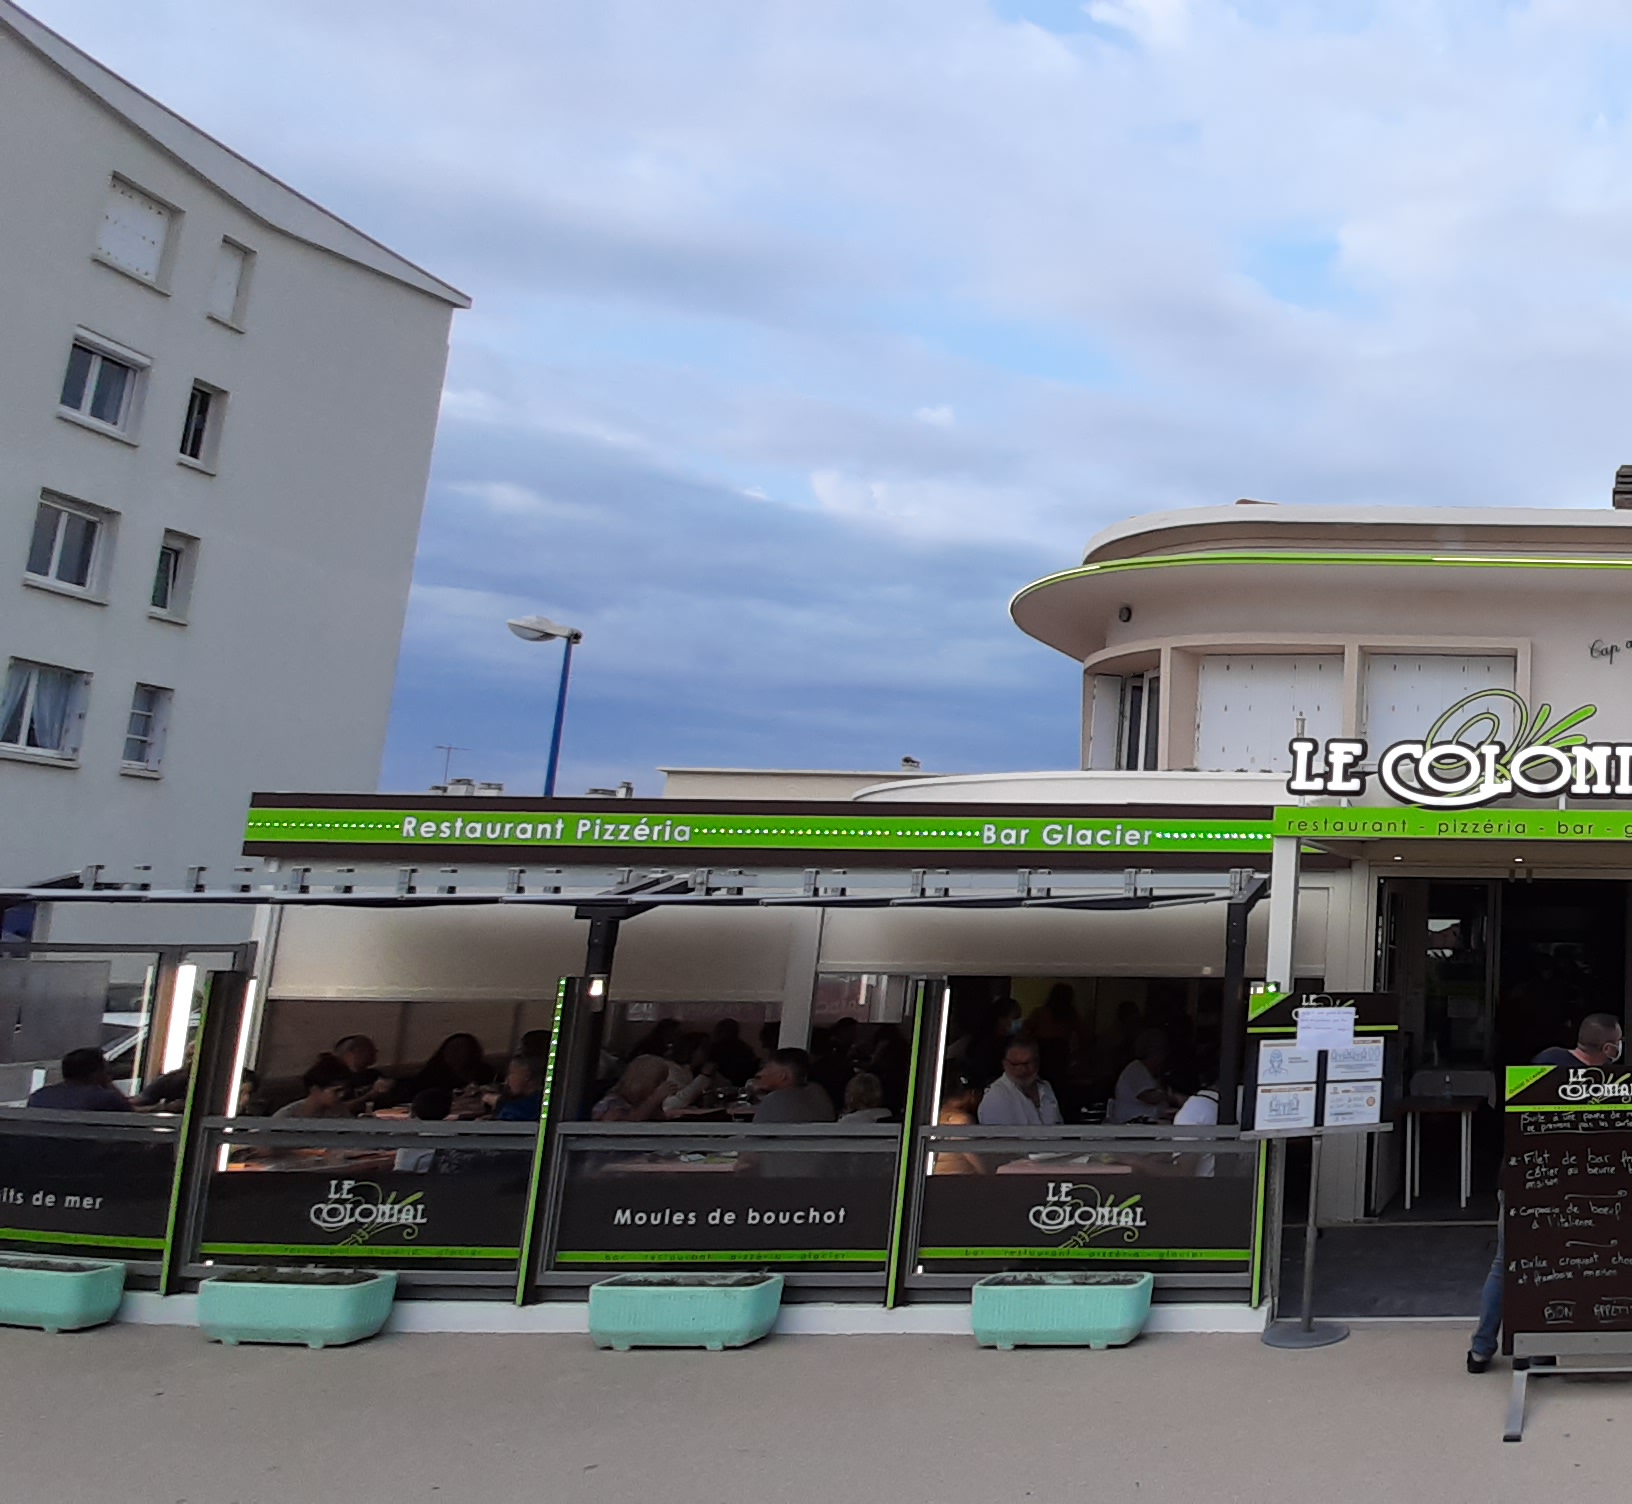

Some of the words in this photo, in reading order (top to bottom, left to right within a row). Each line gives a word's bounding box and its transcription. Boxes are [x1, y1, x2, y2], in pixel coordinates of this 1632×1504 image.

[1589, 639, 1621, 665] Cap
[1290, 740, 1364, 792] LE
[402, 816, 565, 842] Restaurant
[575, 816, 692, 843] Pizzéria
[983, 824, 1030, 845] Bar
[1042, 823, 1153, 847] Glacier
[1287, 818, 1409, 834] restaurant
[1437, 818, 1527, 837] pizzéria
[1557, 820, 1595, 836] bar
[1301, 994, 1317, 1006] LE
[1569, 1068, 1587, 1082] LE
[1610, 1111, 1624, 1119] de
[1578, 1121, 1594, 1131] pas
[1523, 1150, 1550, 1165] Filet
[1562, 1151, 1577, 1165] de
[1588, 1148, 1611, 1163] bar
[1526, 1166, 1560, 1180] côtier
[1567, 1167, 1579, 1176] au
[1586, 1164, 1616, 1175] beurre
[0, 1186, 24, 1204] its
[31, 1190, 56, 1206] de
[63, 1195, 104, 1209] mer
[328, 1180, 355, 1200] LE
[1046, 1182, 1073, 1201] LE
[310, 1203, 428, 1229] COLONIAL
[613, 1208, 697, 1226] Moules
[707, 1207, 737, 1225] de
[747, 1206, 847, 1225] bouchot
[1566, 1202, 1580, 1214] de
[1028, 1206, 1147, 1230] COLONIAL
[1559, 1251, 1599, 1268] croquant
[1543, 1306, 1573, 1320] BON
